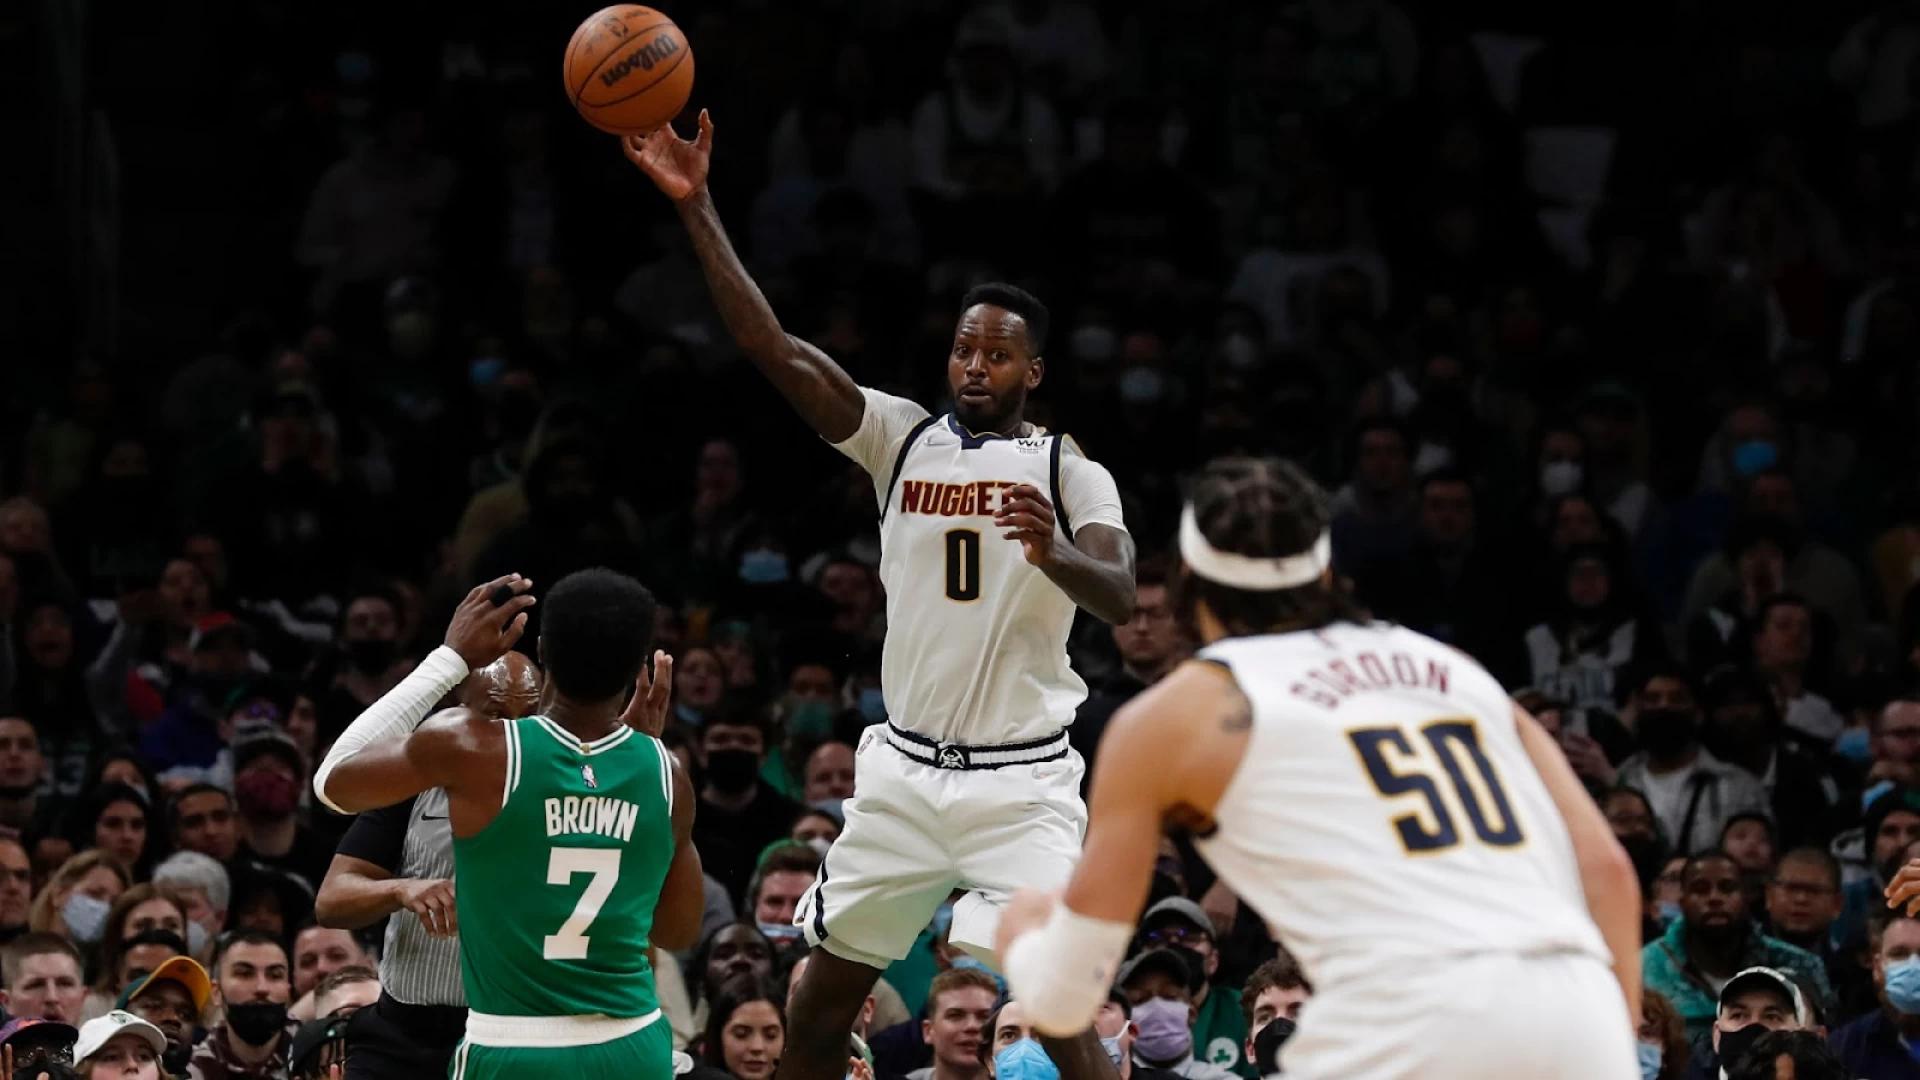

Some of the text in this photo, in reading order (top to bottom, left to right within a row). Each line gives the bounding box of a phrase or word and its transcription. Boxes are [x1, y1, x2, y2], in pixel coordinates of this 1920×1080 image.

[599, 33, 680, 88] Wilson
[901, 480, 1032, 517] NUGGET
[945, 527, 981, 604] 0
[1290, 652, 1450, 709] GORDON
[1344, 717, 1528, 858] 50
[545, 796, 639, 843] BROWN
[543, 846, 622, 960] 7
